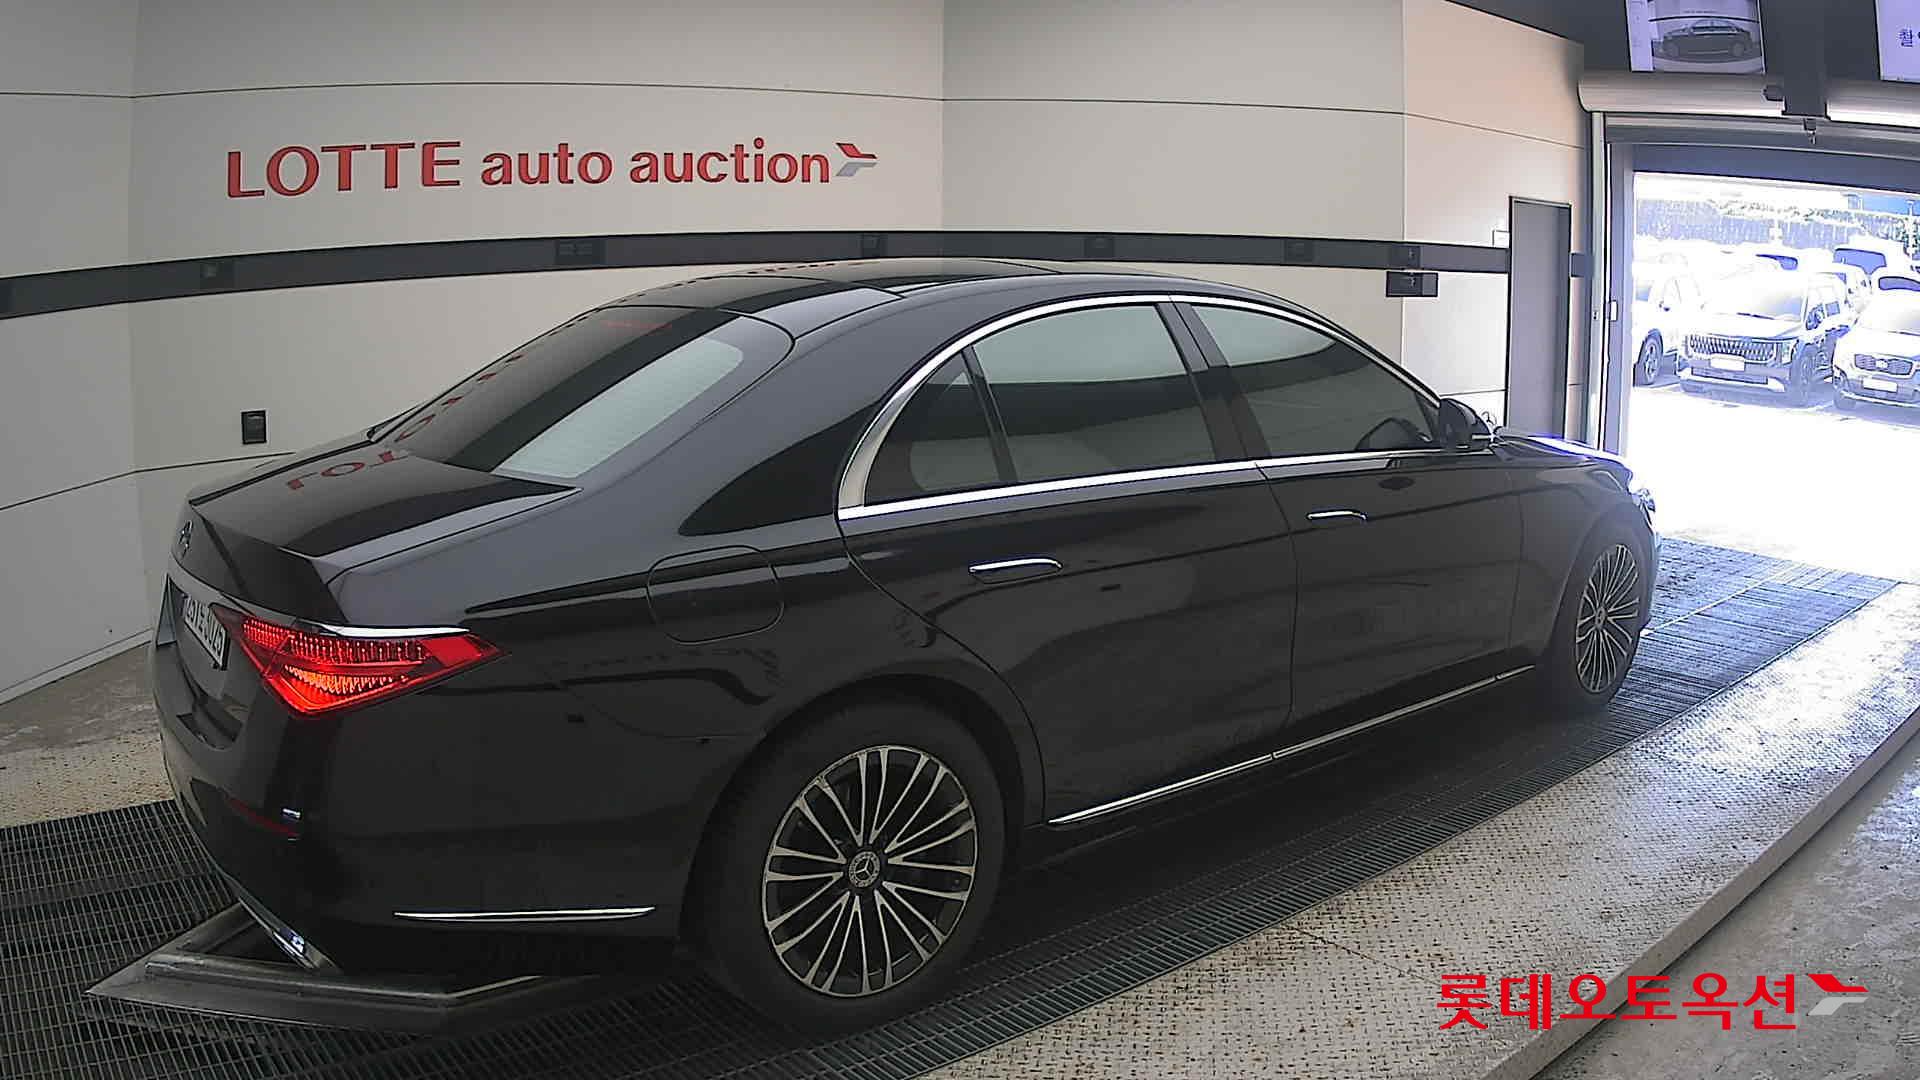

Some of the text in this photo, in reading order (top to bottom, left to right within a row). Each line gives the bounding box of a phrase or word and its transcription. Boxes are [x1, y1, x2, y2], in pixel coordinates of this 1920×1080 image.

[227, 137, 832, 198] LOTTE auto auction
